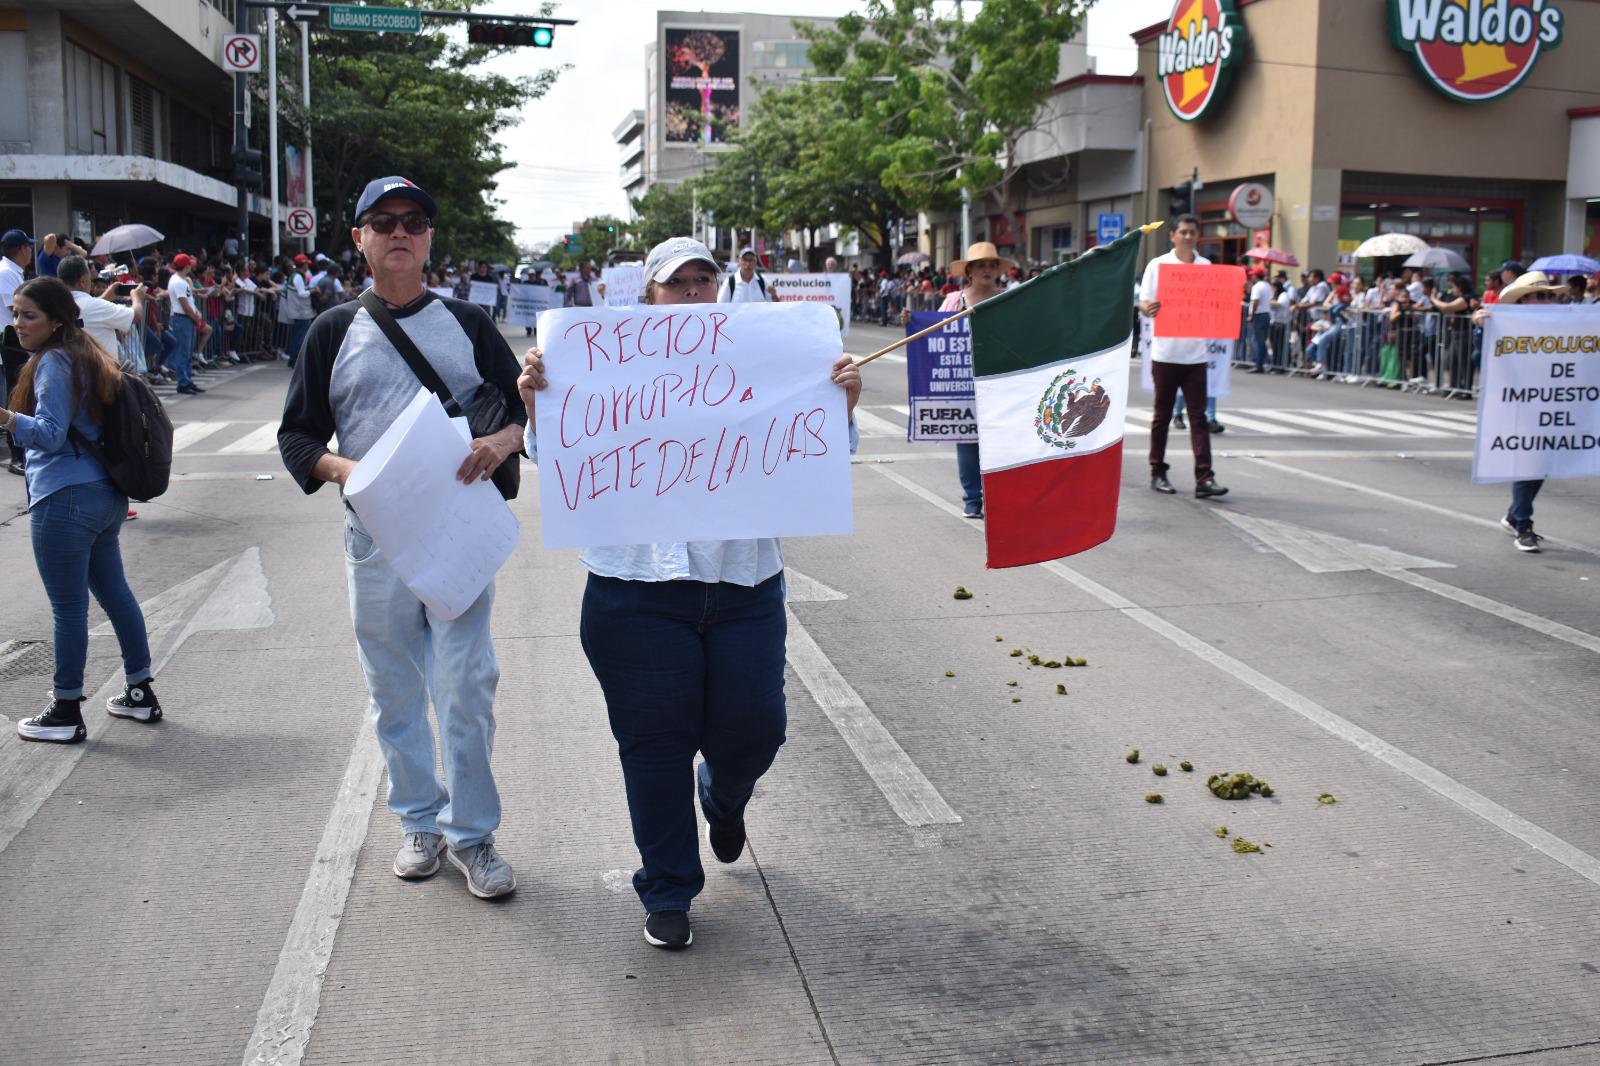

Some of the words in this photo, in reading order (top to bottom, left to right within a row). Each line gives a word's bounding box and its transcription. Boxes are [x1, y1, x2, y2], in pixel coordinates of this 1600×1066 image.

[333, 12, 371, 27] MARIANO
[372, 14, 417, 29] ESCOBEDO
[1398, 0, 1564, 44] Waldo's
[1158, 12, 1233, 77] Waldo's
[772, 278, 832, 288] devolucion
[779, 293, 804, 302] ente
[805, 294, 836, 302] como
[564, 312, 734, 371] RECTOR
[928, 337, 946, 353] NO
[949, 337, 972, 353] EST
[1494, 335, 1600, 357] ¡DEVOLUCI
[940, 353, 962, 366] ESTÁ
[932, 368, 951, 379] POR
[952, 368, 974, 379] TANT
[1550, 363, 1576, 379] DE
[930, 381, 975, 393] UNIVERSIT
[920, 408, 975, 421] FUERA
[1539, 411, 1576, 427] DEL
[921, 424, 978, 435] RECTOR
[1491, 435, 1600, 451] AGUINALD
[555, 437, 652, 510] VETE
[762, 407, 828, 476] UAS
